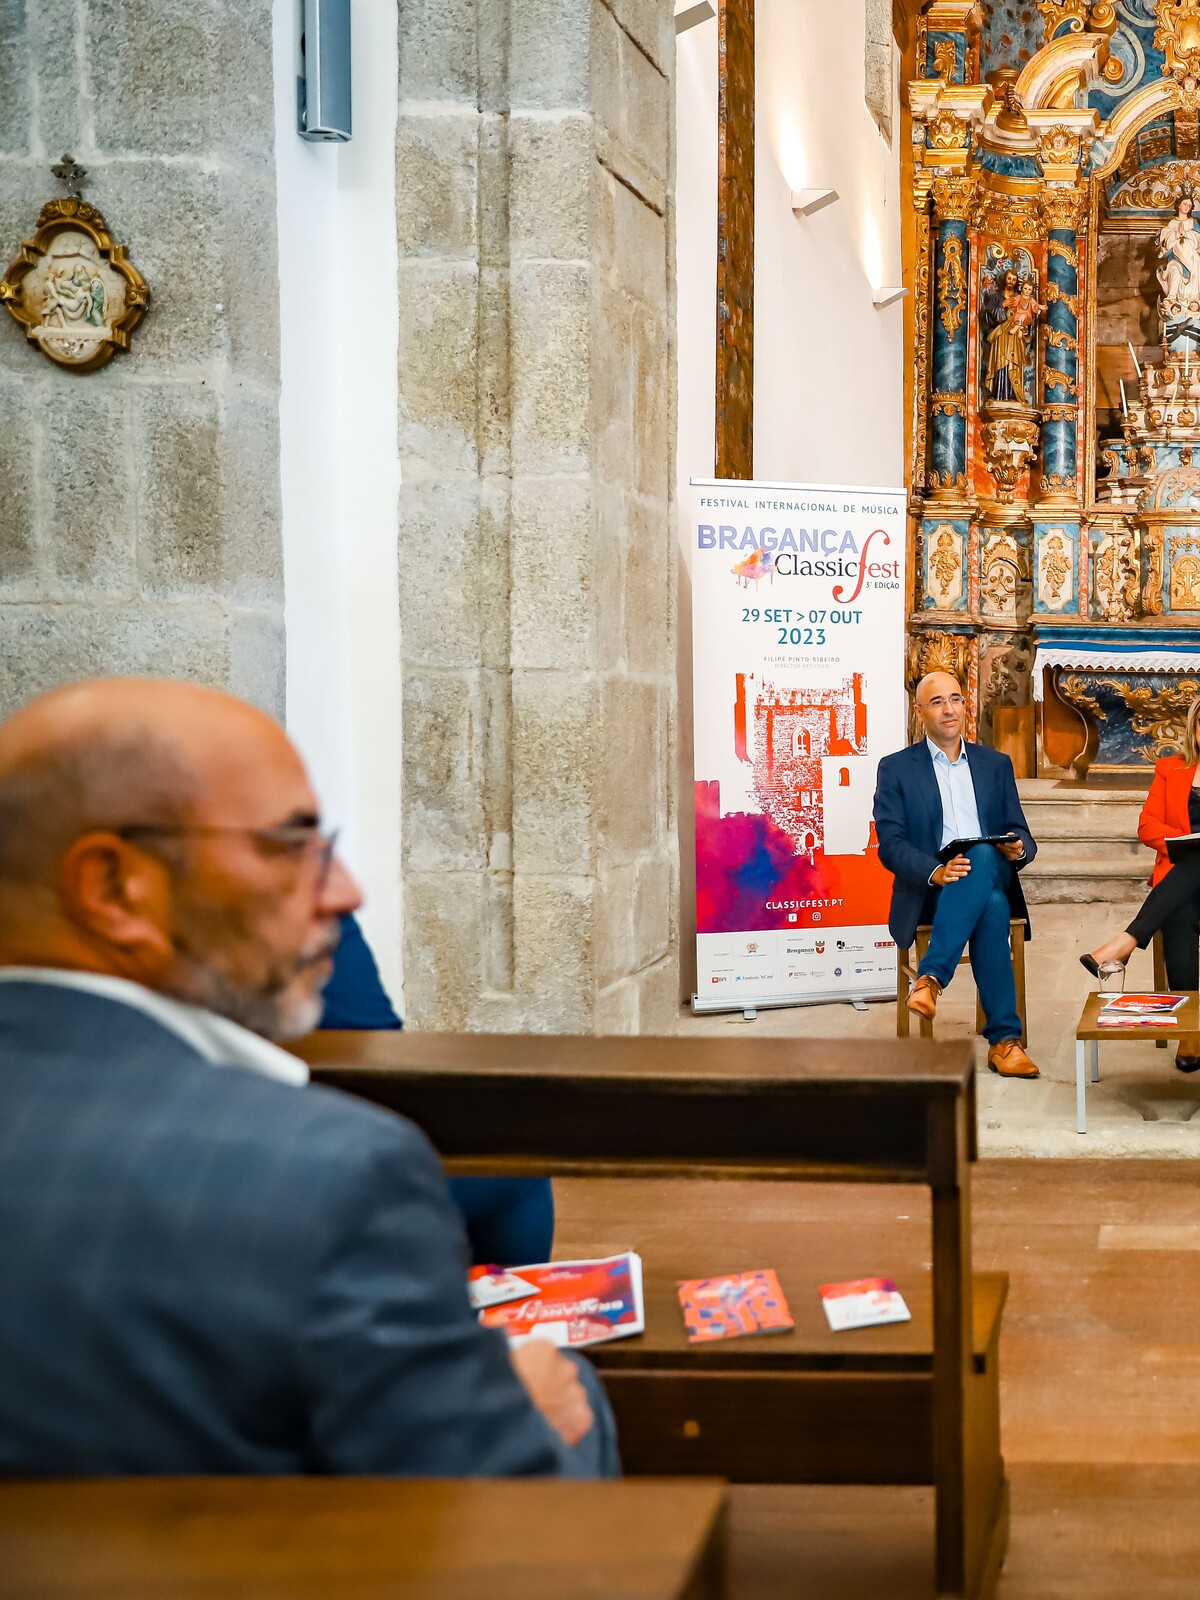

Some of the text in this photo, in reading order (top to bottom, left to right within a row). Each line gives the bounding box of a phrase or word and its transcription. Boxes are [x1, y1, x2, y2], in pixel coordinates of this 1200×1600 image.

[700, 498, 899, 516] FESTIVAL INTERNACIONAL DE MÚSICA
[698, 524, 858, 557] BRAGANÇA
[874, 581, 900, 590] EDIÇÃO
[741, 608, 760, 622] 29
[764, 609, 793, 623] SET
[808, 610, 827, 623] 07
[830, 610, 863, 625] OUT
[777, 628, 826, 645] 2023
[765, 898, 844, 910] CLASSICFEST.PT
